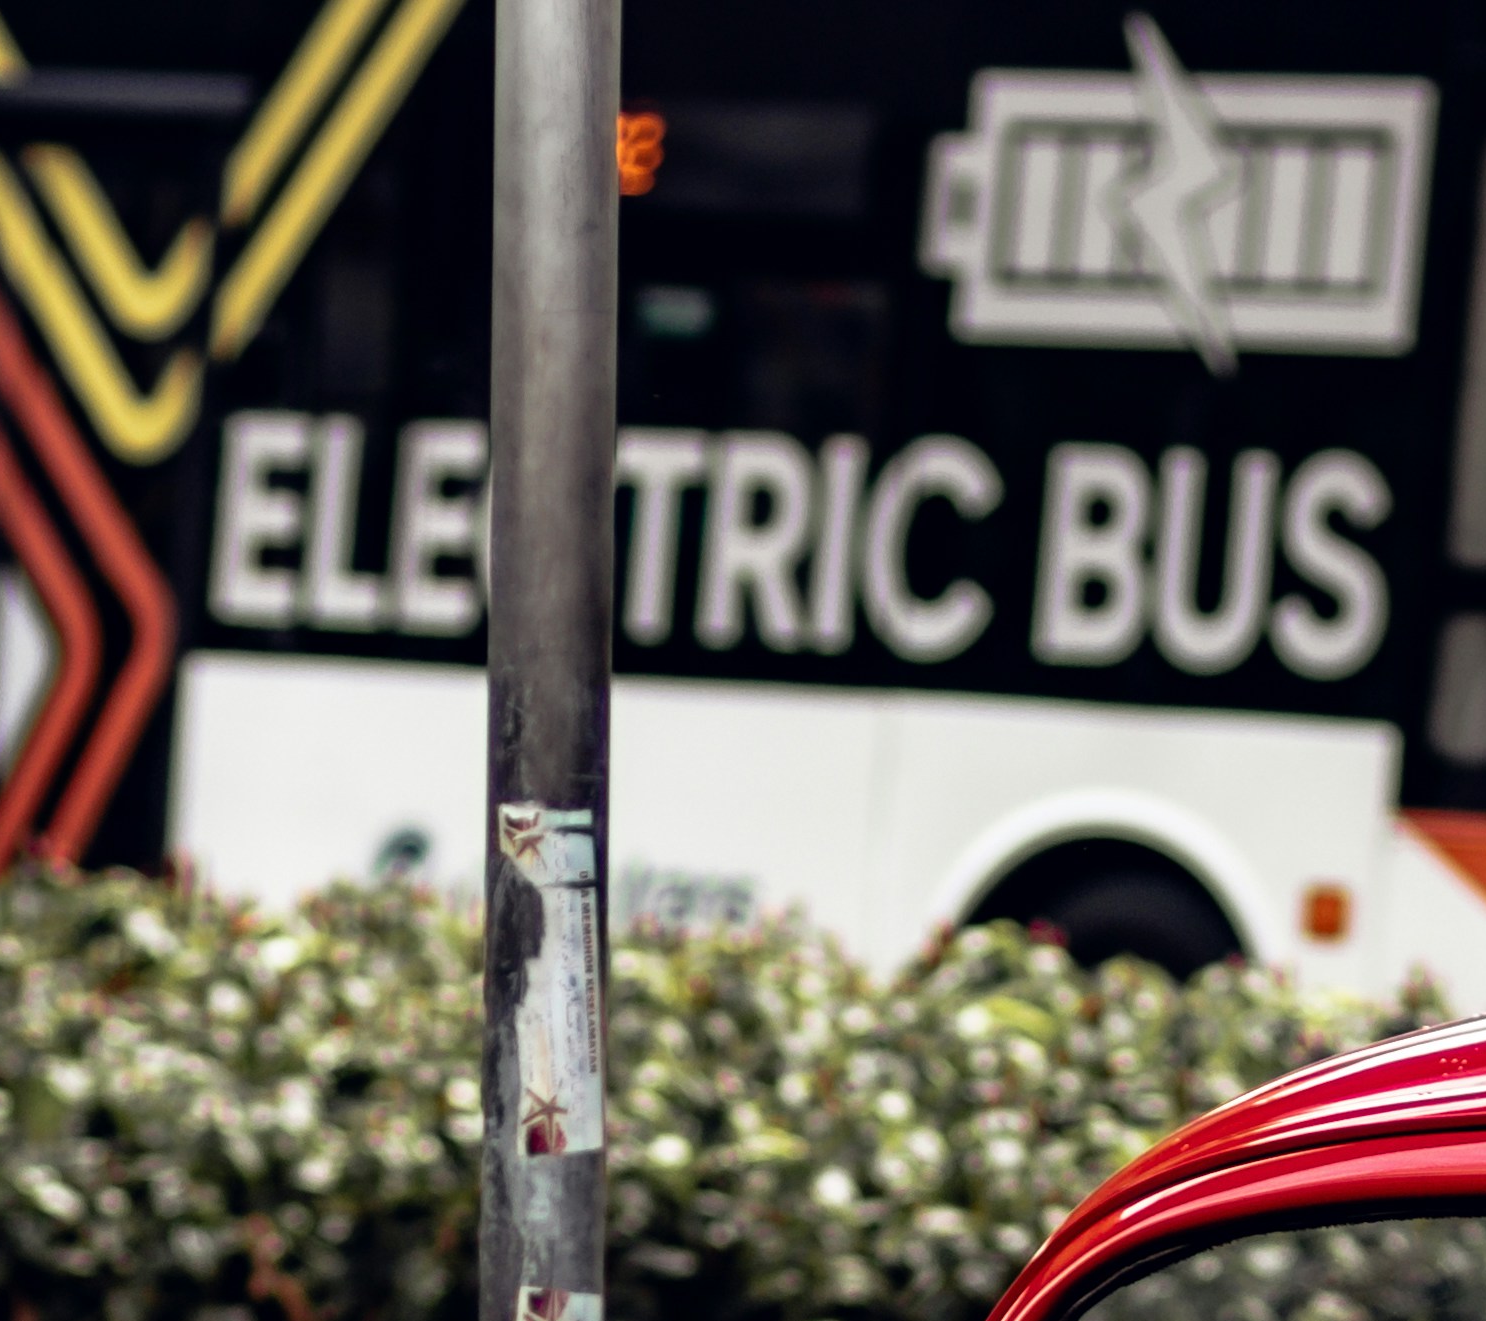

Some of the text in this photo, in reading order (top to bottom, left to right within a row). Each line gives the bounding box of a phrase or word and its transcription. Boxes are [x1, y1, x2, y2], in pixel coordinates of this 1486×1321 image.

[208, 408, 1394, 681] ELETRIC BUS
[579, 870, 591, 898] DA
